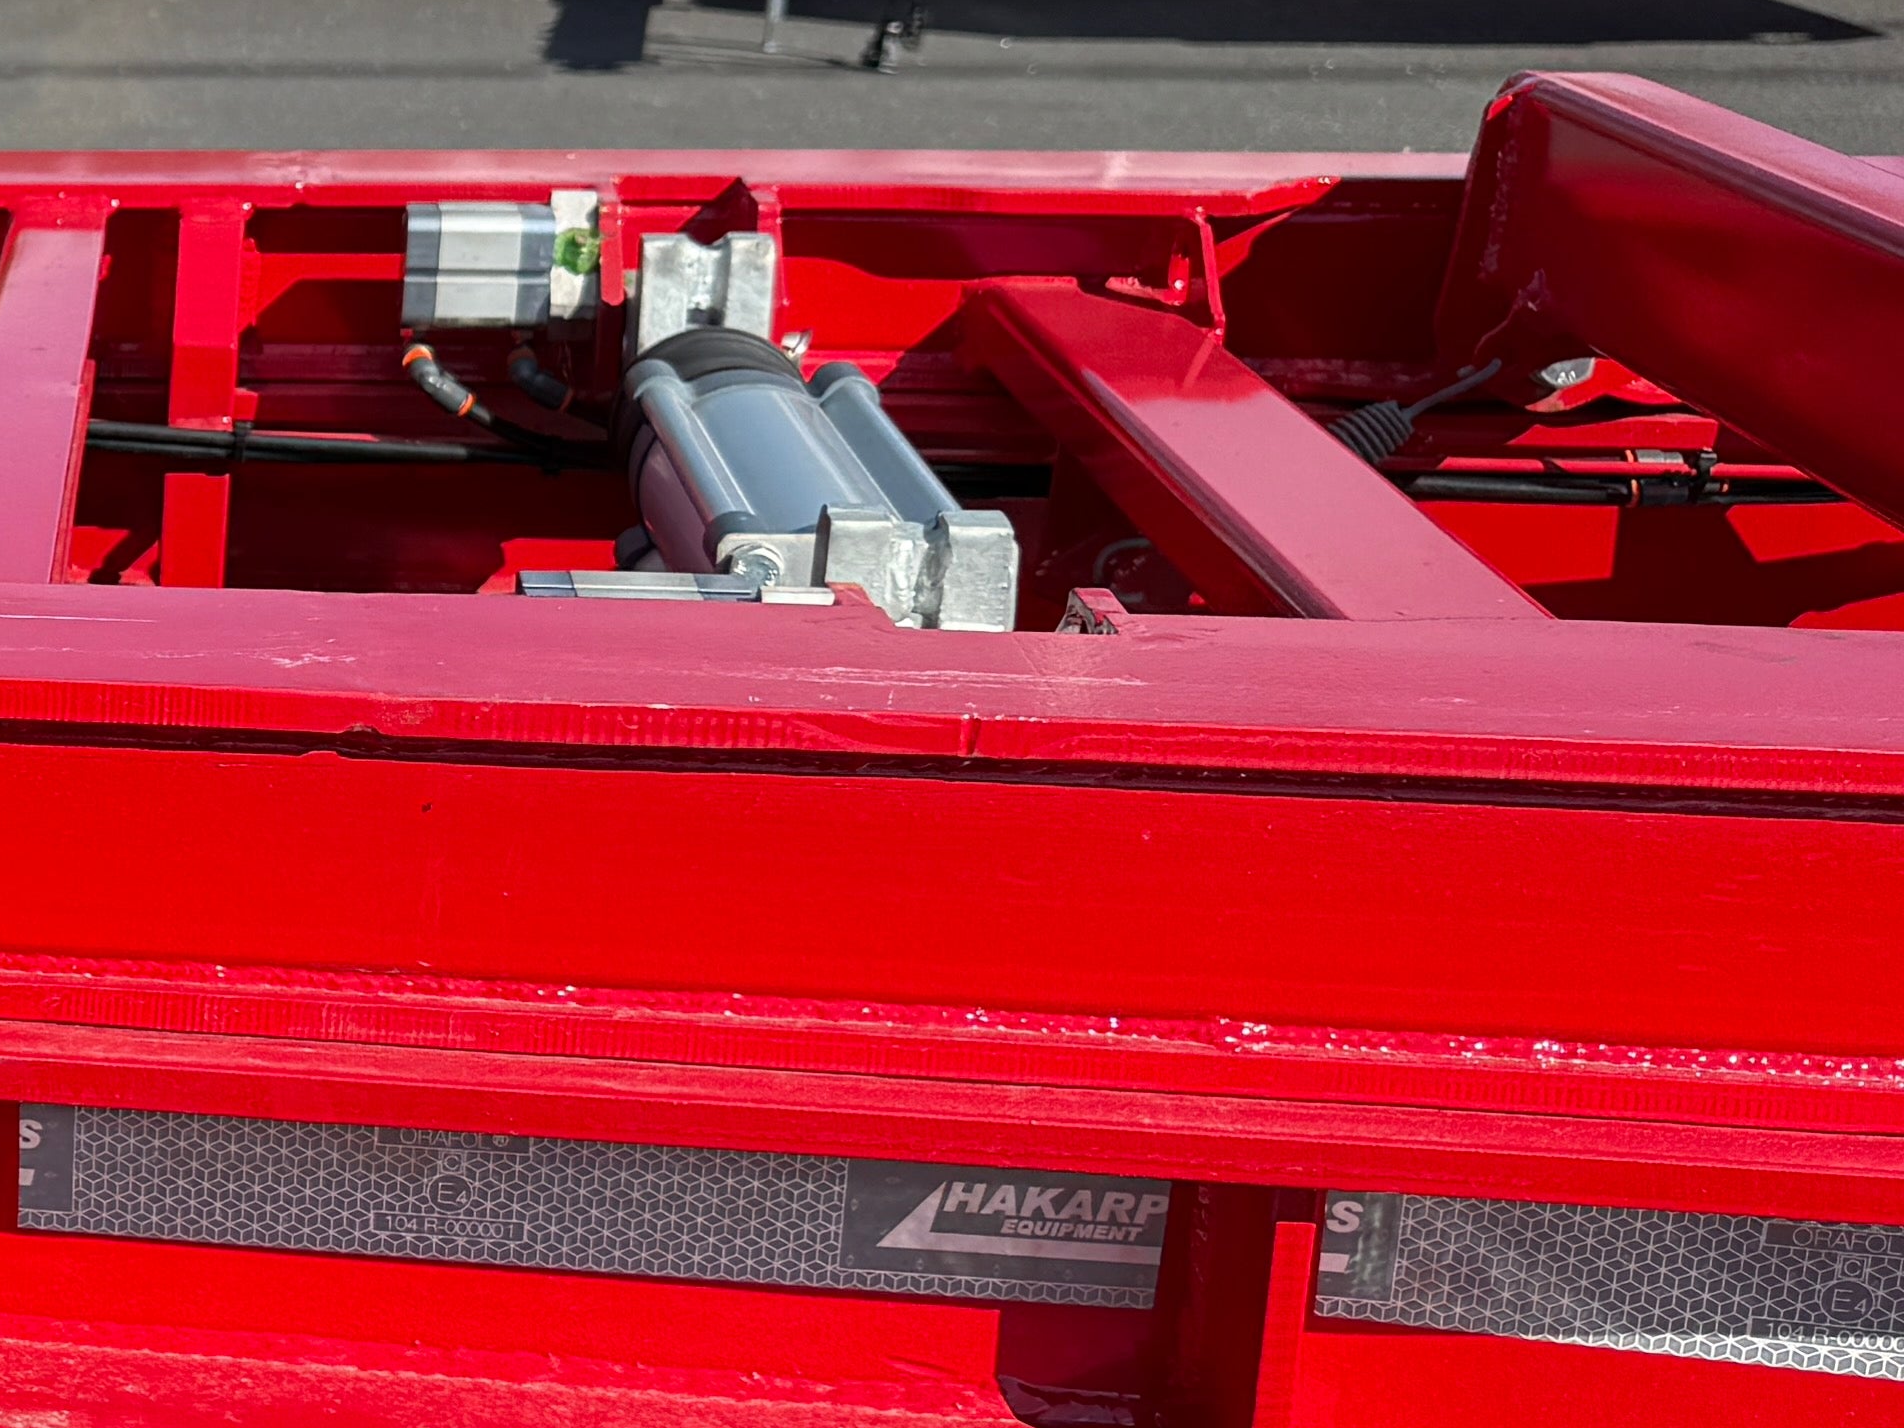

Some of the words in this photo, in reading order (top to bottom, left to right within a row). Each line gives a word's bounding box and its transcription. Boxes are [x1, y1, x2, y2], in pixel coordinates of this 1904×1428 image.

[386, 1216, 417, 1231] 104
[1326, 1200, 1363, 1233] S
[1000, 1219, 1143, 1241] EQUIPMENT
[1767, 1323, 1805, 1342] 104
